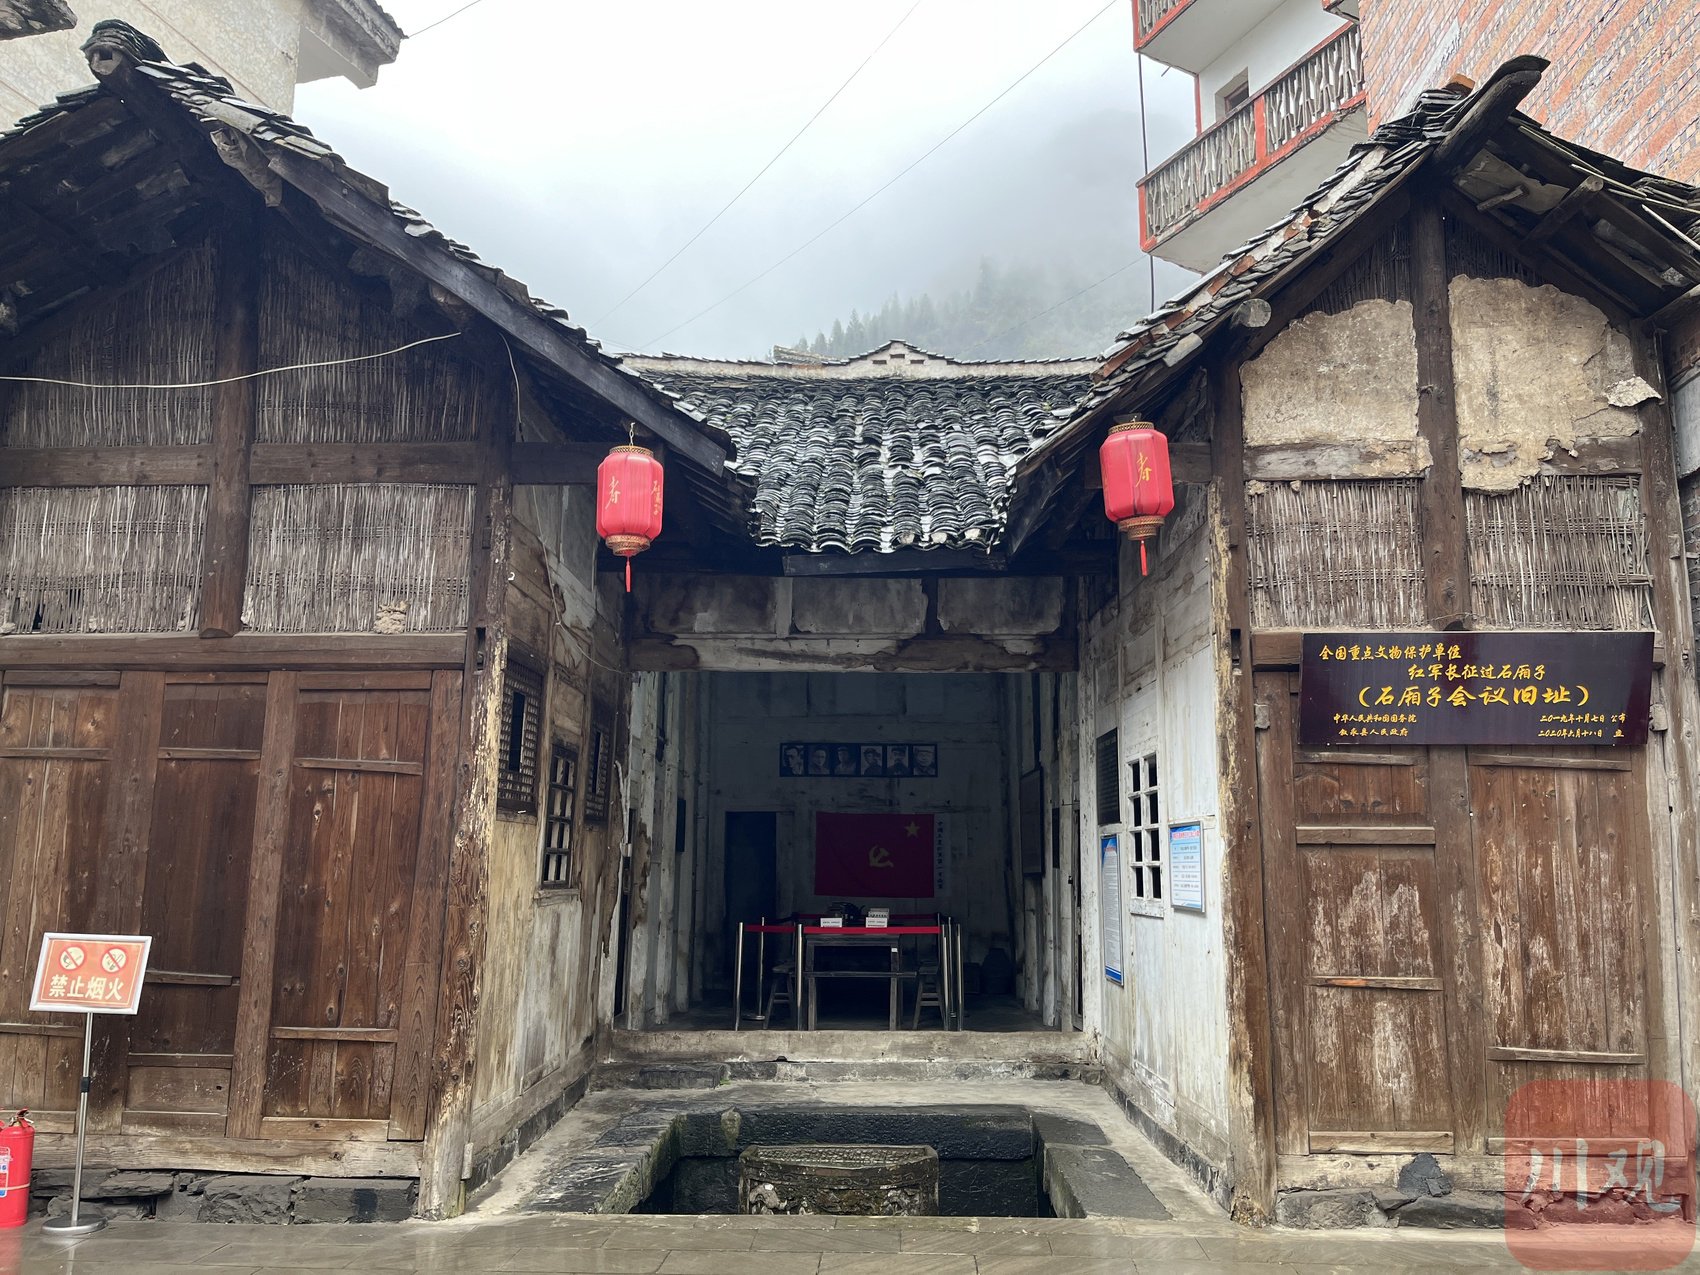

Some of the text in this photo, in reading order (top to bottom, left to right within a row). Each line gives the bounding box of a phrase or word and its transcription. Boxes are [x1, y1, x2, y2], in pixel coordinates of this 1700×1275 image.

[1319, 642, 1462, 661] 全国重点文物保护单位
[1407, 663, 1546, 681] 红军长征过石厢子
[1358, 685, 1590, 708] （石厢子会议旧址）
[1333, 713, 1417, 724] 中华人民共和国国务院
[1338, 727, 1409, 737] 叙永县人民政府
[48, 973, 124, 1001] 禁止烟火
